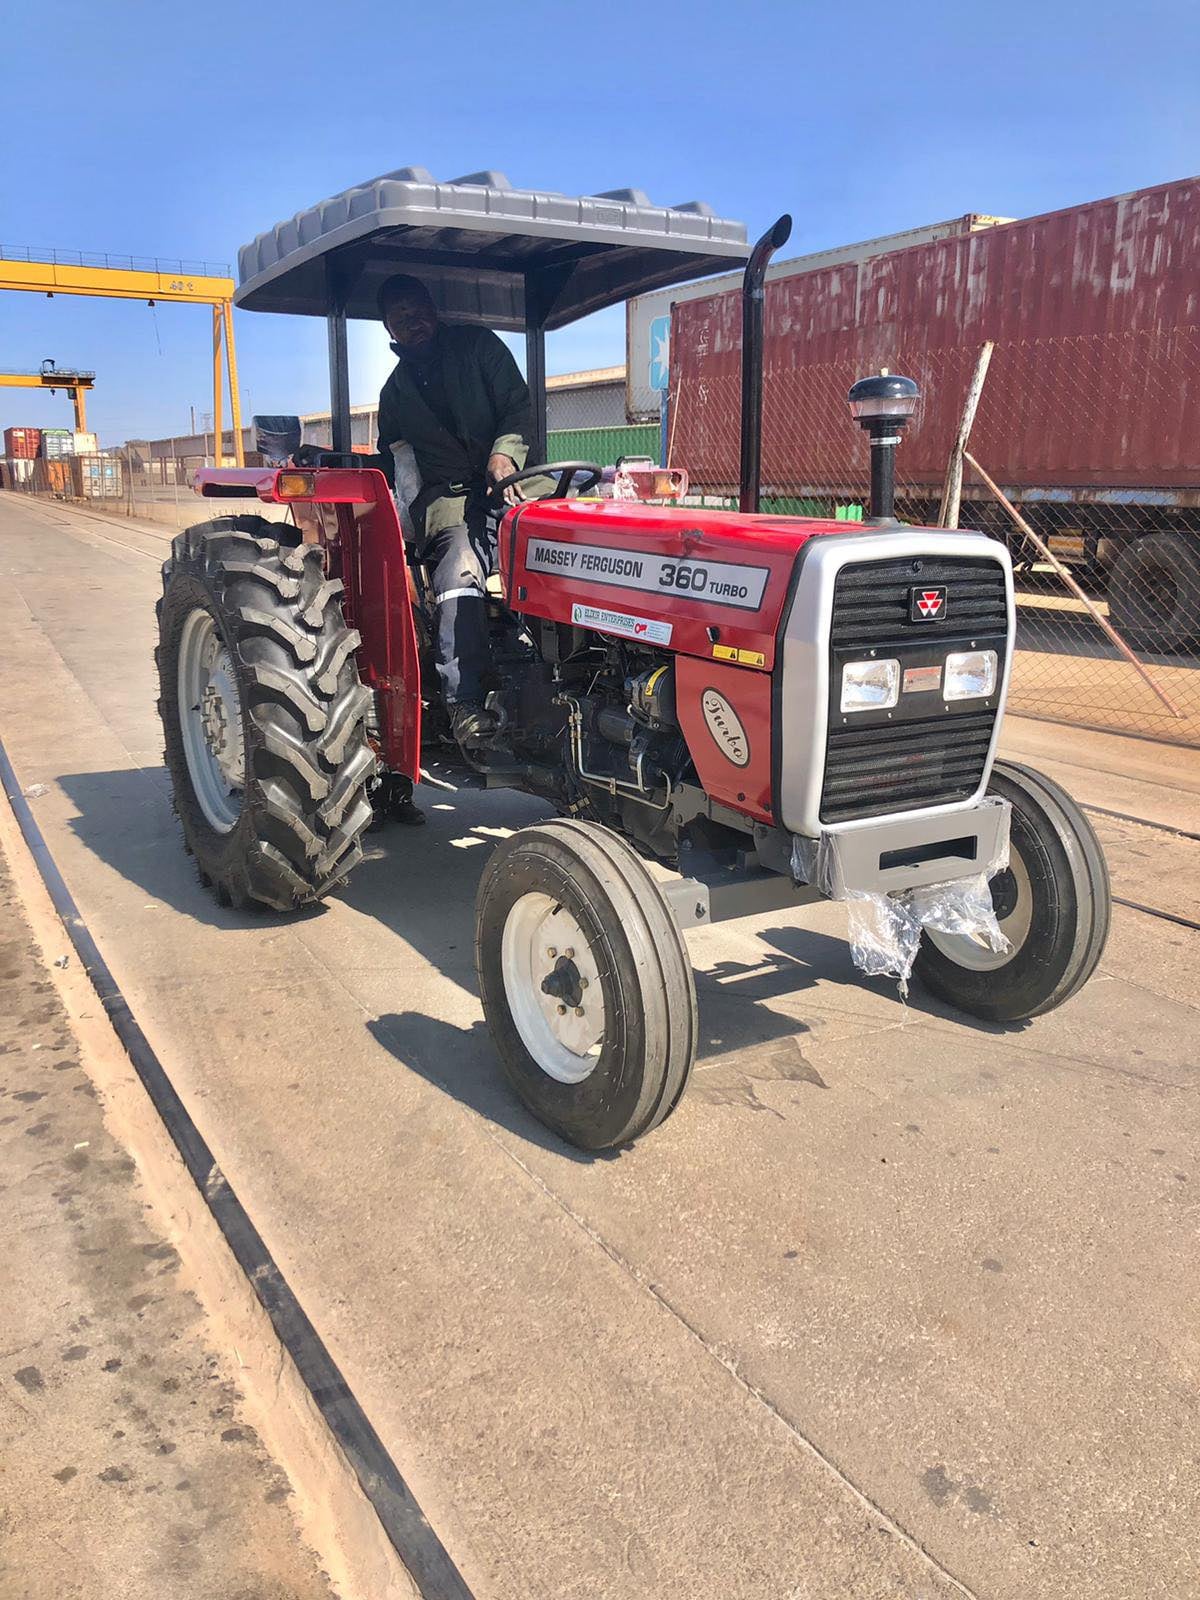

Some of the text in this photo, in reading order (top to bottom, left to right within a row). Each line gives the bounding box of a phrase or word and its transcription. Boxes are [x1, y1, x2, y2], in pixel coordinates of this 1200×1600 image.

[535, 547, 748, 598] MASSEY FERGUSON 360 TURBO
[601, 612, 635, 627] ENTERPRISES
[705, 698, 741, 759] Turbo
